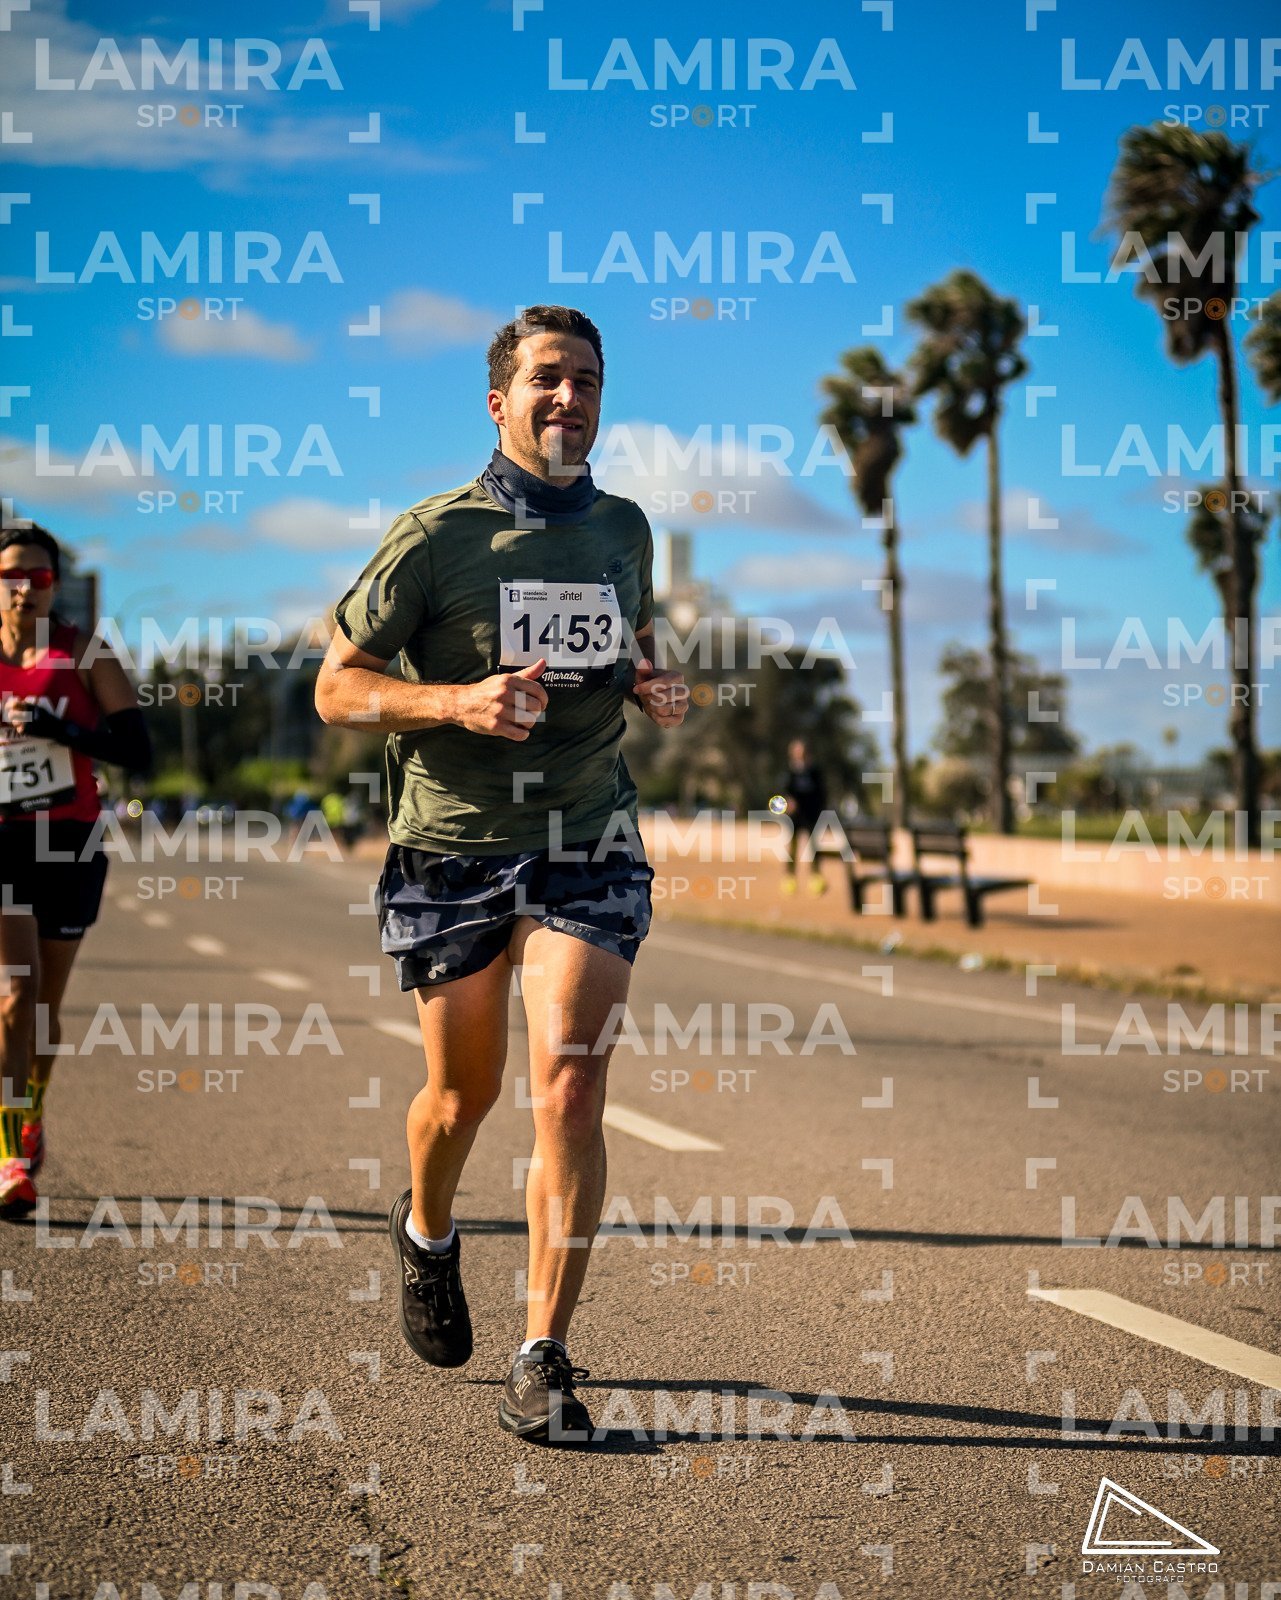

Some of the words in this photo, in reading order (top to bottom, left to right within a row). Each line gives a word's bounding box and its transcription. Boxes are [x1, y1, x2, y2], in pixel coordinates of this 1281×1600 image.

[559, 590, 582, 601] antel
[512, 613, 613, 653] 1453
[541, 670, 584, 683] Maratón
[1, 758, 54, 792] 751
